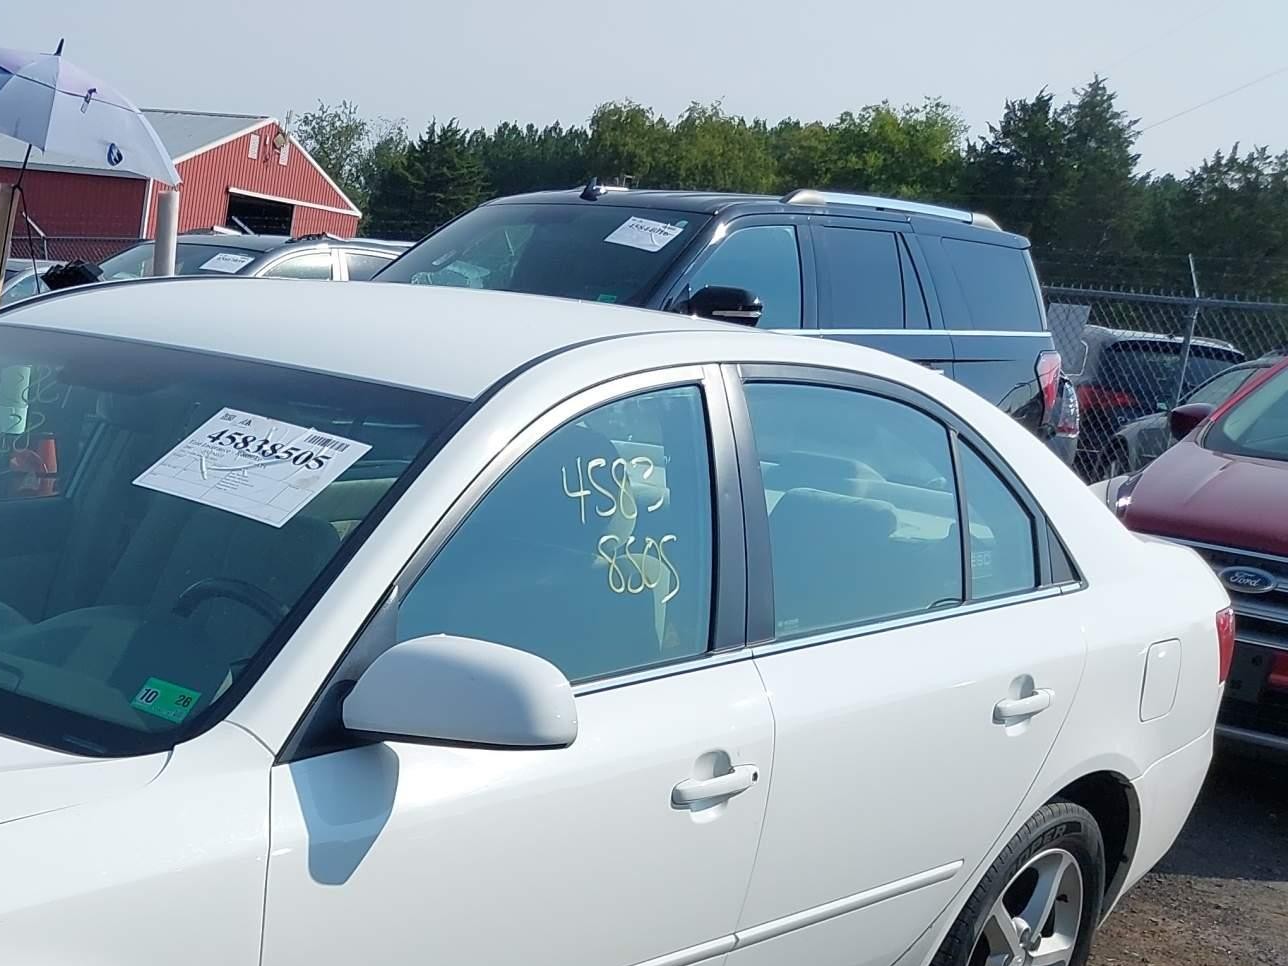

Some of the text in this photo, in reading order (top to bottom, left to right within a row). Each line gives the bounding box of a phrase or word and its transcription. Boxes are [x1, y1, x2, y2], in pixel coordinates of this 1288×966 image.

[207, 429, 332, 470] 45838505
[561, 456, 665, 525] 4583
[598, 534, 680, 604] 8505
[1230, 571, 1261, 587] Ford
[140, 688, 193, 708] 10 26
